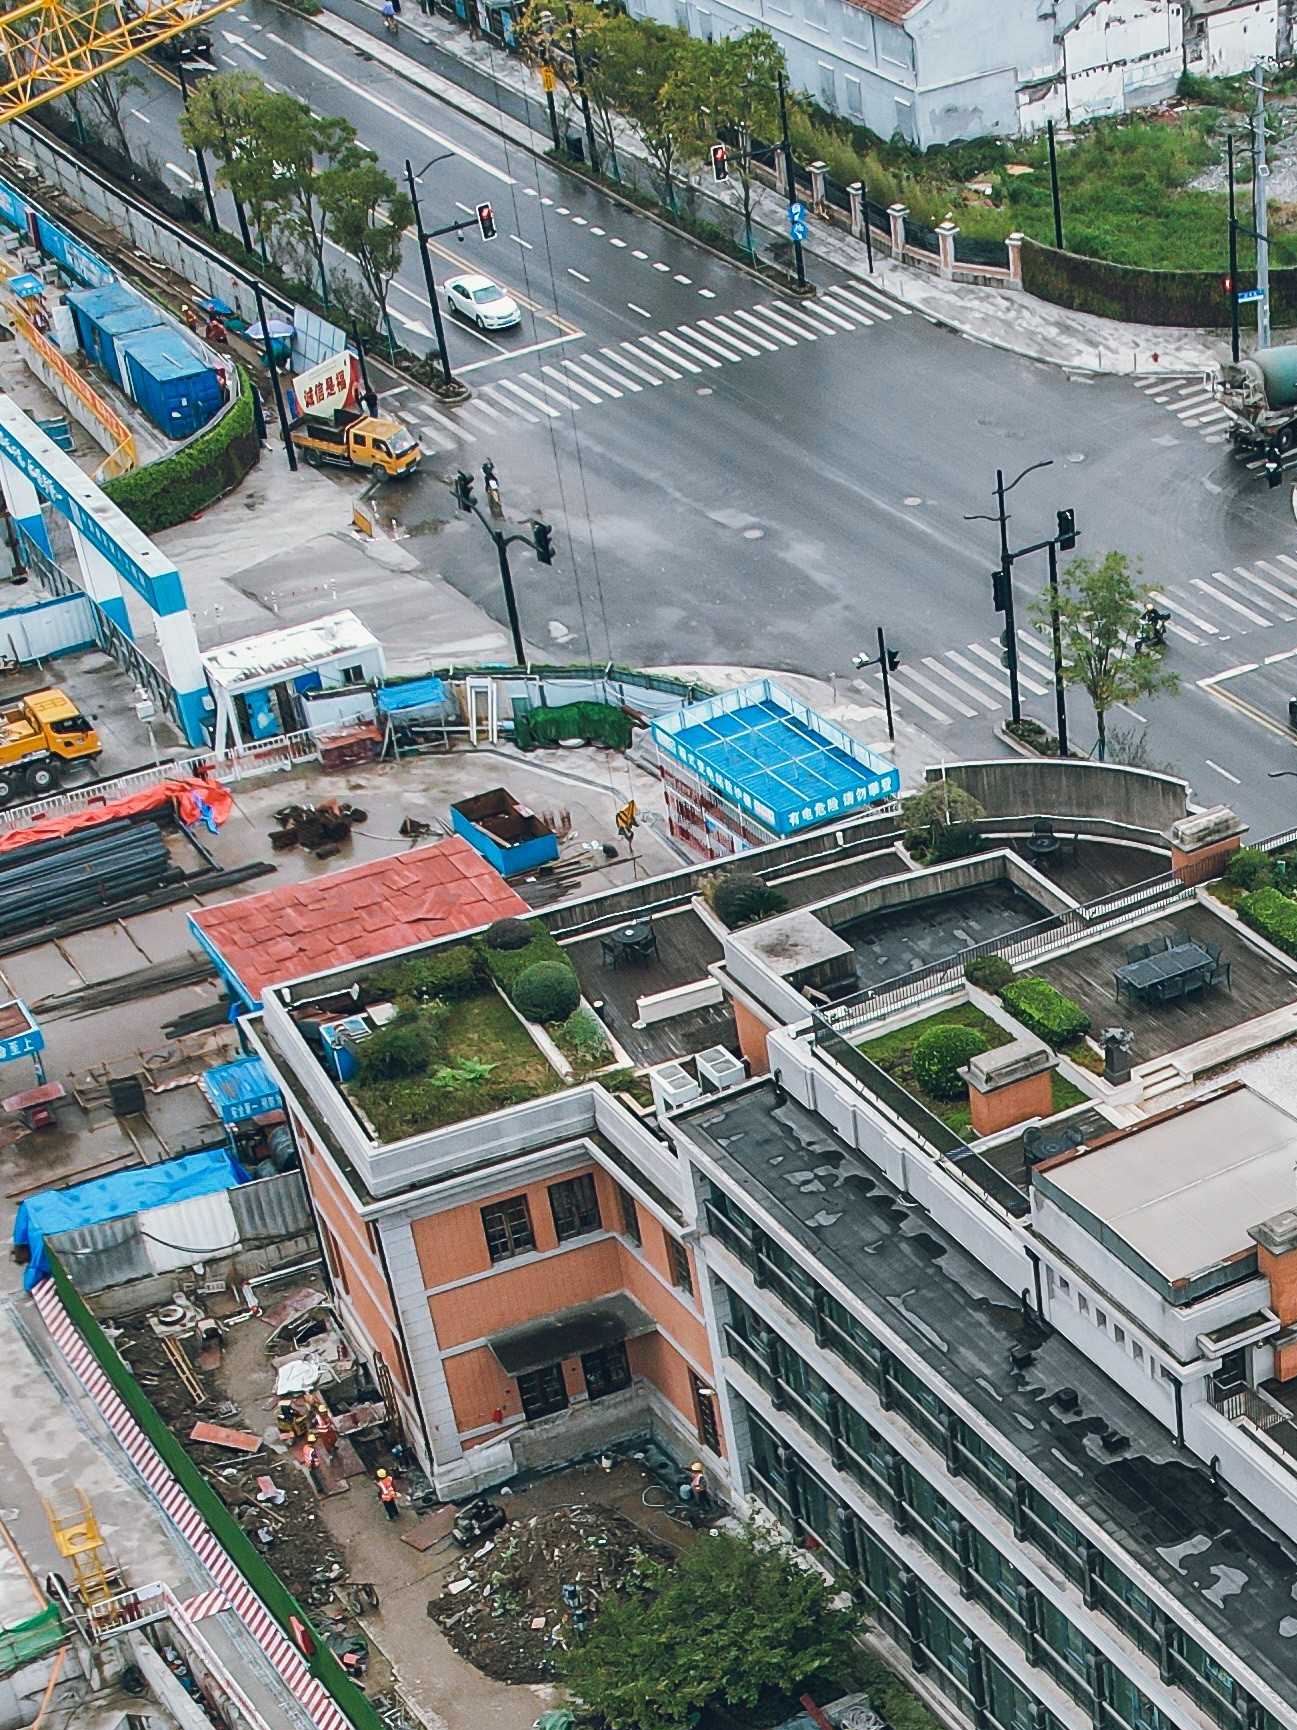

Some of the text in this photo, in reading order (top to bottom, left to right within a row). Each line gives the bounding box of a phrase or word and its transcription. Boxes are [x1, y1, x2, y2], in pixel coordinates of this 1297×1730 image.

[303, 369, 347, 408] 诚信是福
[788, 797, 839, 828] 有电危险
